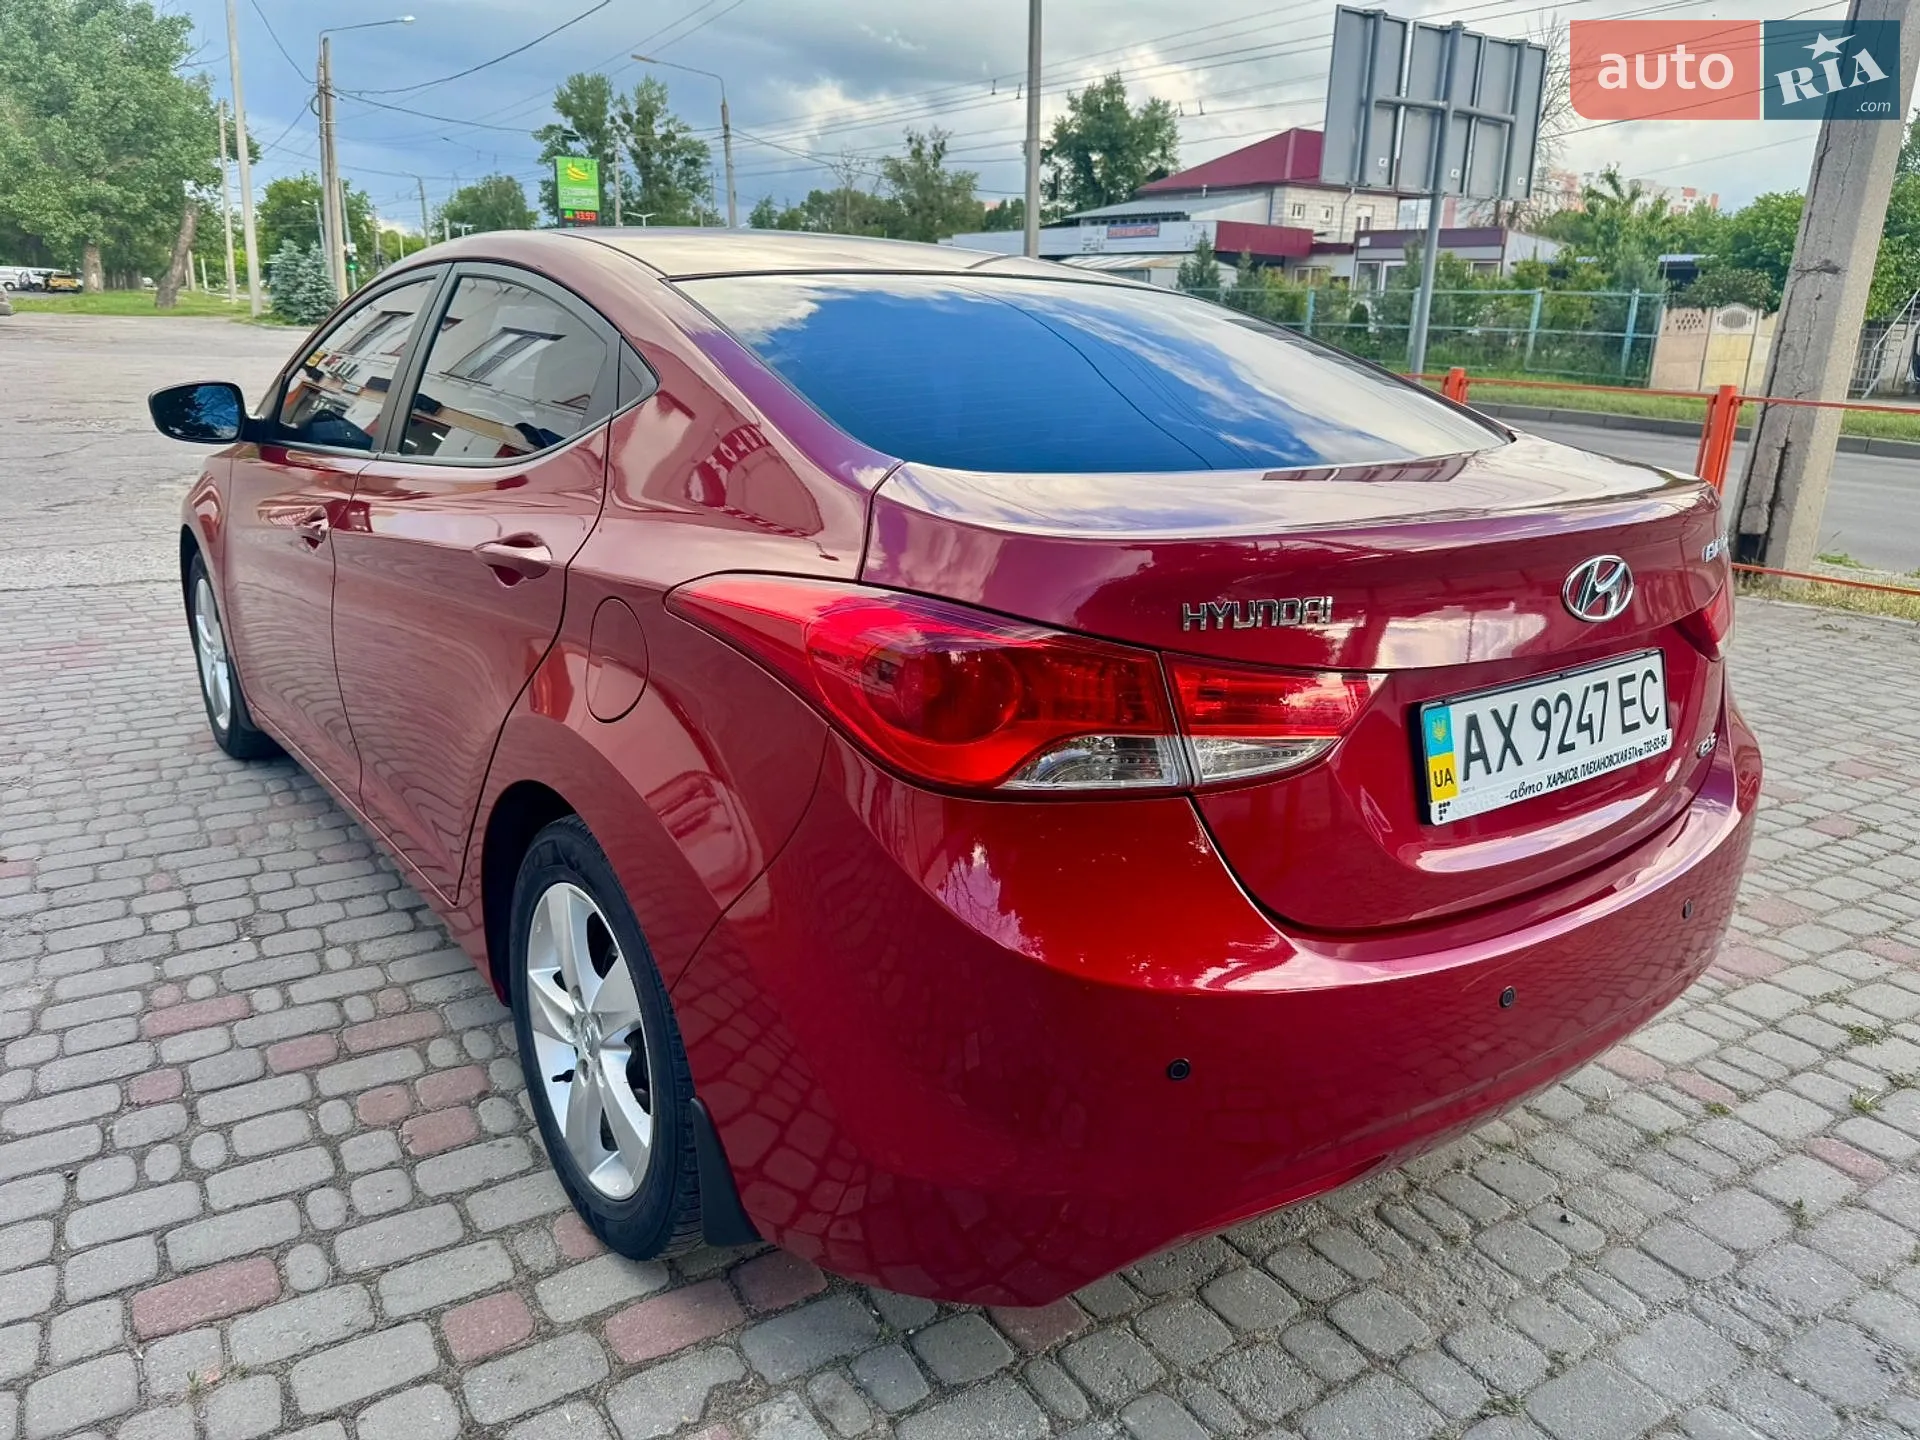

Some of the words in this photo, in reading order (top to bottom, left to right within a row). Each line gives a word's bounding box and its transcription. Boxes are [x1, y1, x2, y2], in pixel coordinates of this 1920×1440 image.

[1182, 596, 1334, 632] HYUNDAI
[1462, 702, 1524, 782] AX
[1531, 679, 1610, 762] 9247
[1617, 668, 1660, 735] EC
[1433, 768, 1455, 788] UA
